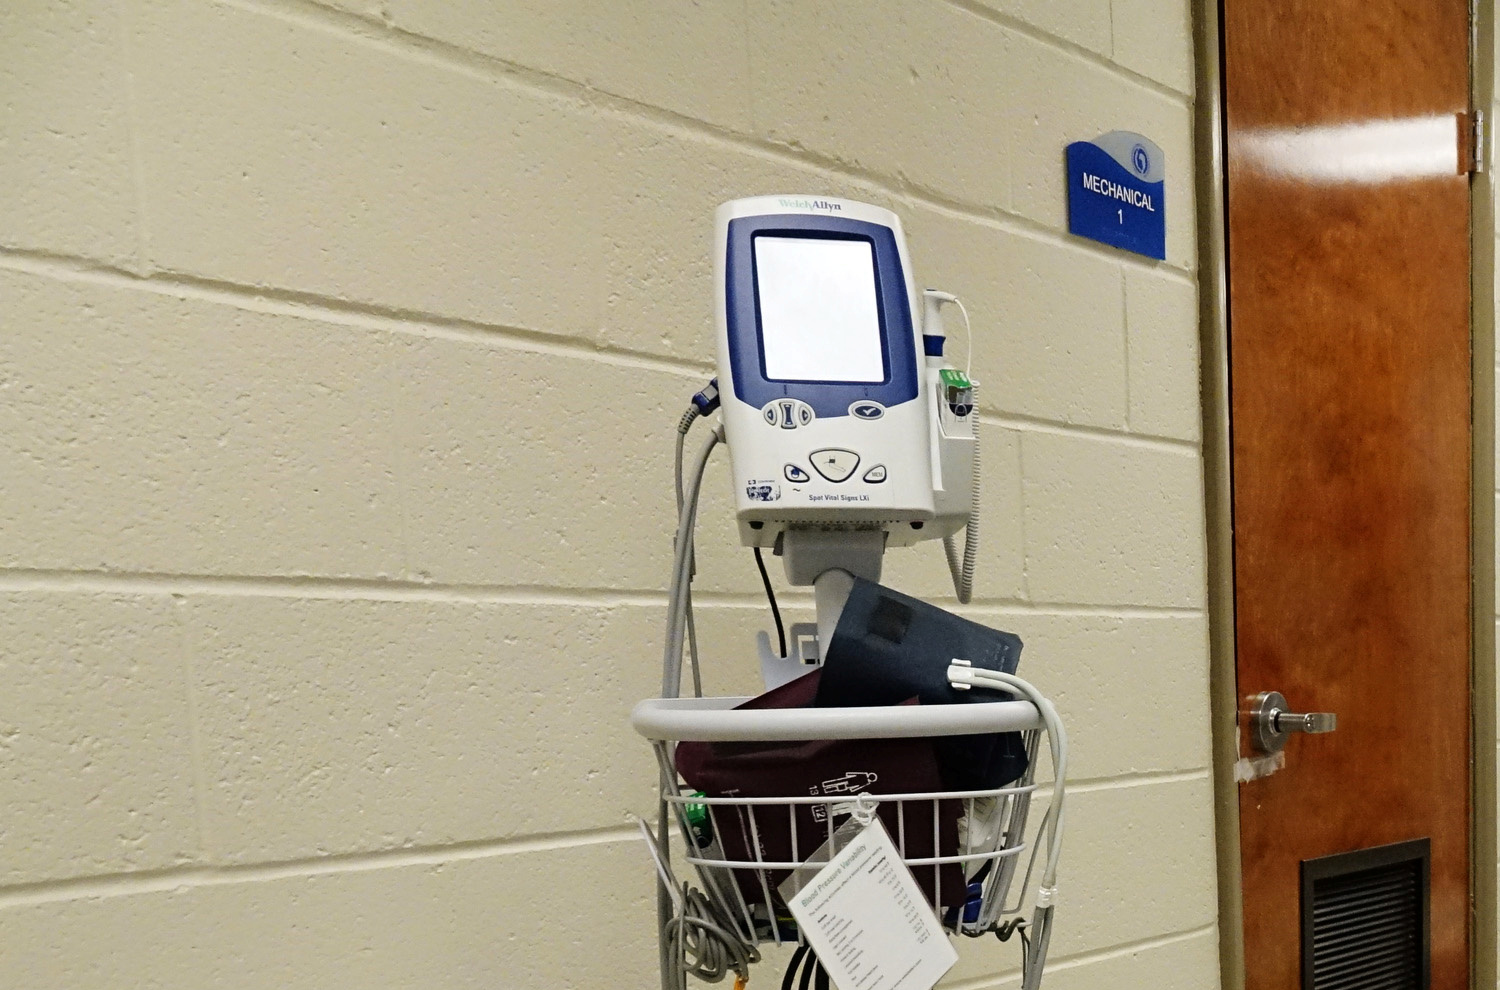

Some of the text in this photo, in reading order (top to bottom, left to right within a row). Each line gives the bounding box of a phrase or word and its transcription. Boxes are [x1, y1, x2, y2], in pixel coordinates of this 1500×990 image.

[1083, 172, 1155, 212] MECHANICAL
[1117, 208, 1123, 224] 1
[808, 785, 819, 796] 13
[815, 807, 826, 818] 12
[801, 890, 818, 907] Blood
[818, 868, 842, 891] Pressure
[840, 845, 866, 869] Variability
